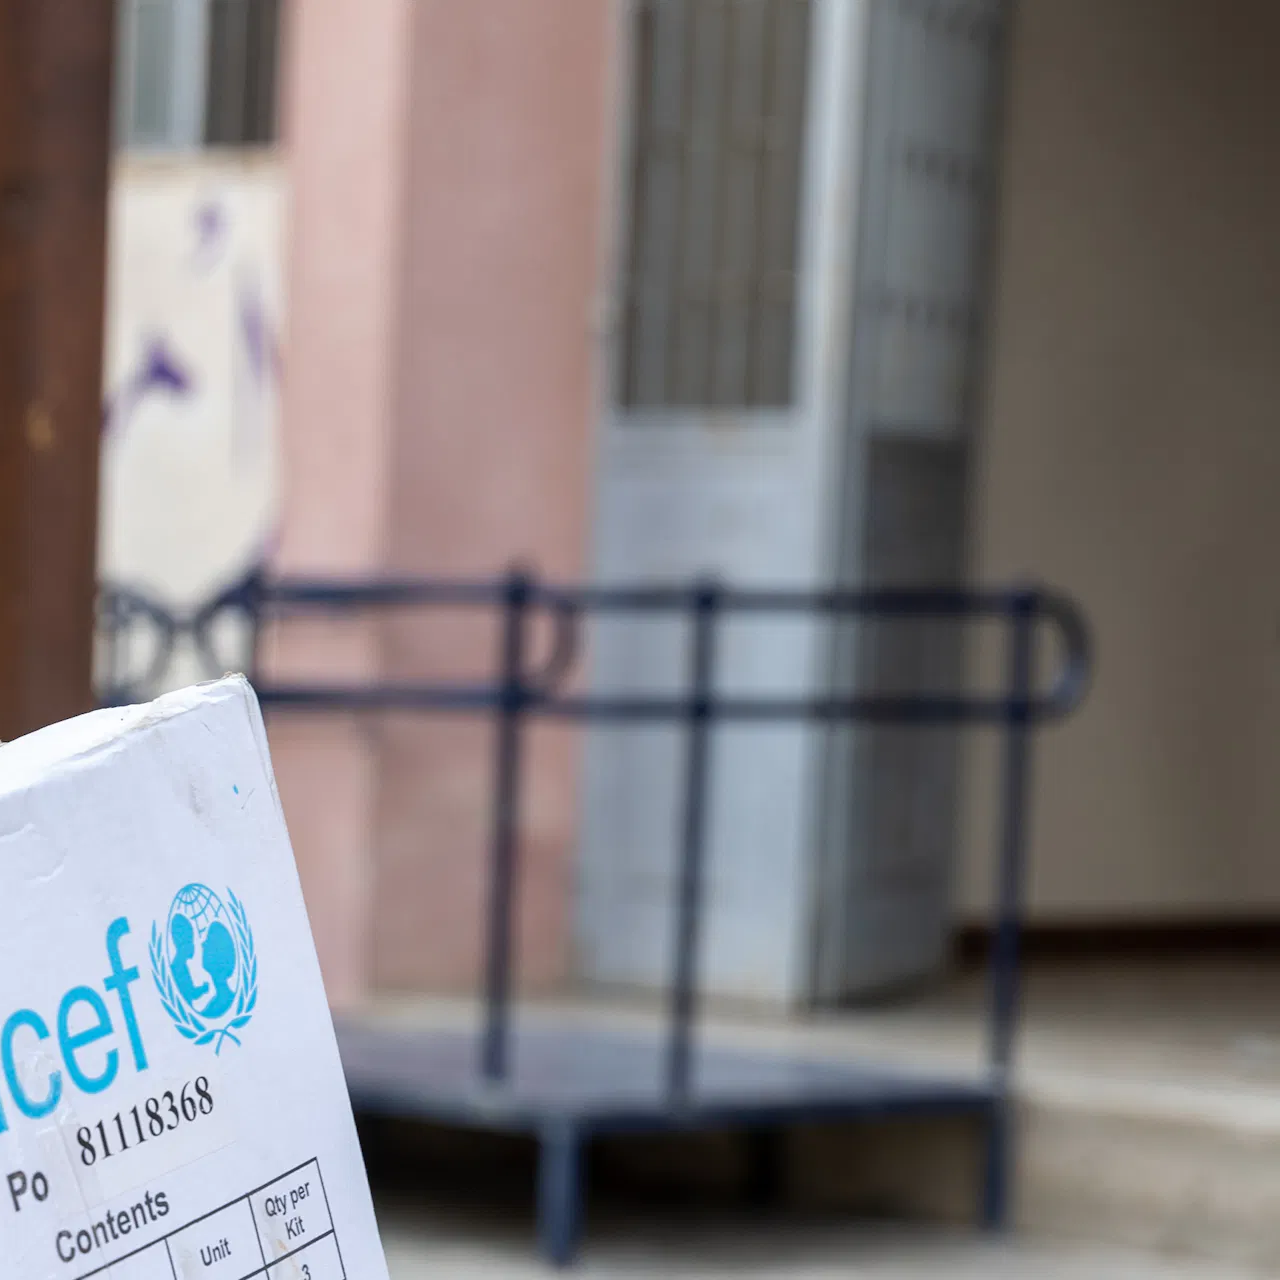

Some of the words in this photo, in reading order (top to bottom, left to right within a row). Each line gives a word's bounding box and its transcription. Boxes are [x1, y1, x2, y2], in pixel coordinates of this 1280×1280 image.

[5, 1169, 50, 1213] Po
[75, 1075, 214, 1167] 81118368
[263, 1194, 288, 1218] Qty
[288, 1181, 310, 1211] per
[54, 1189, 171, 1264] Contents
[284, 1215, 306, 1241] Kit
[199, 1237, 232, 1267] Unit
